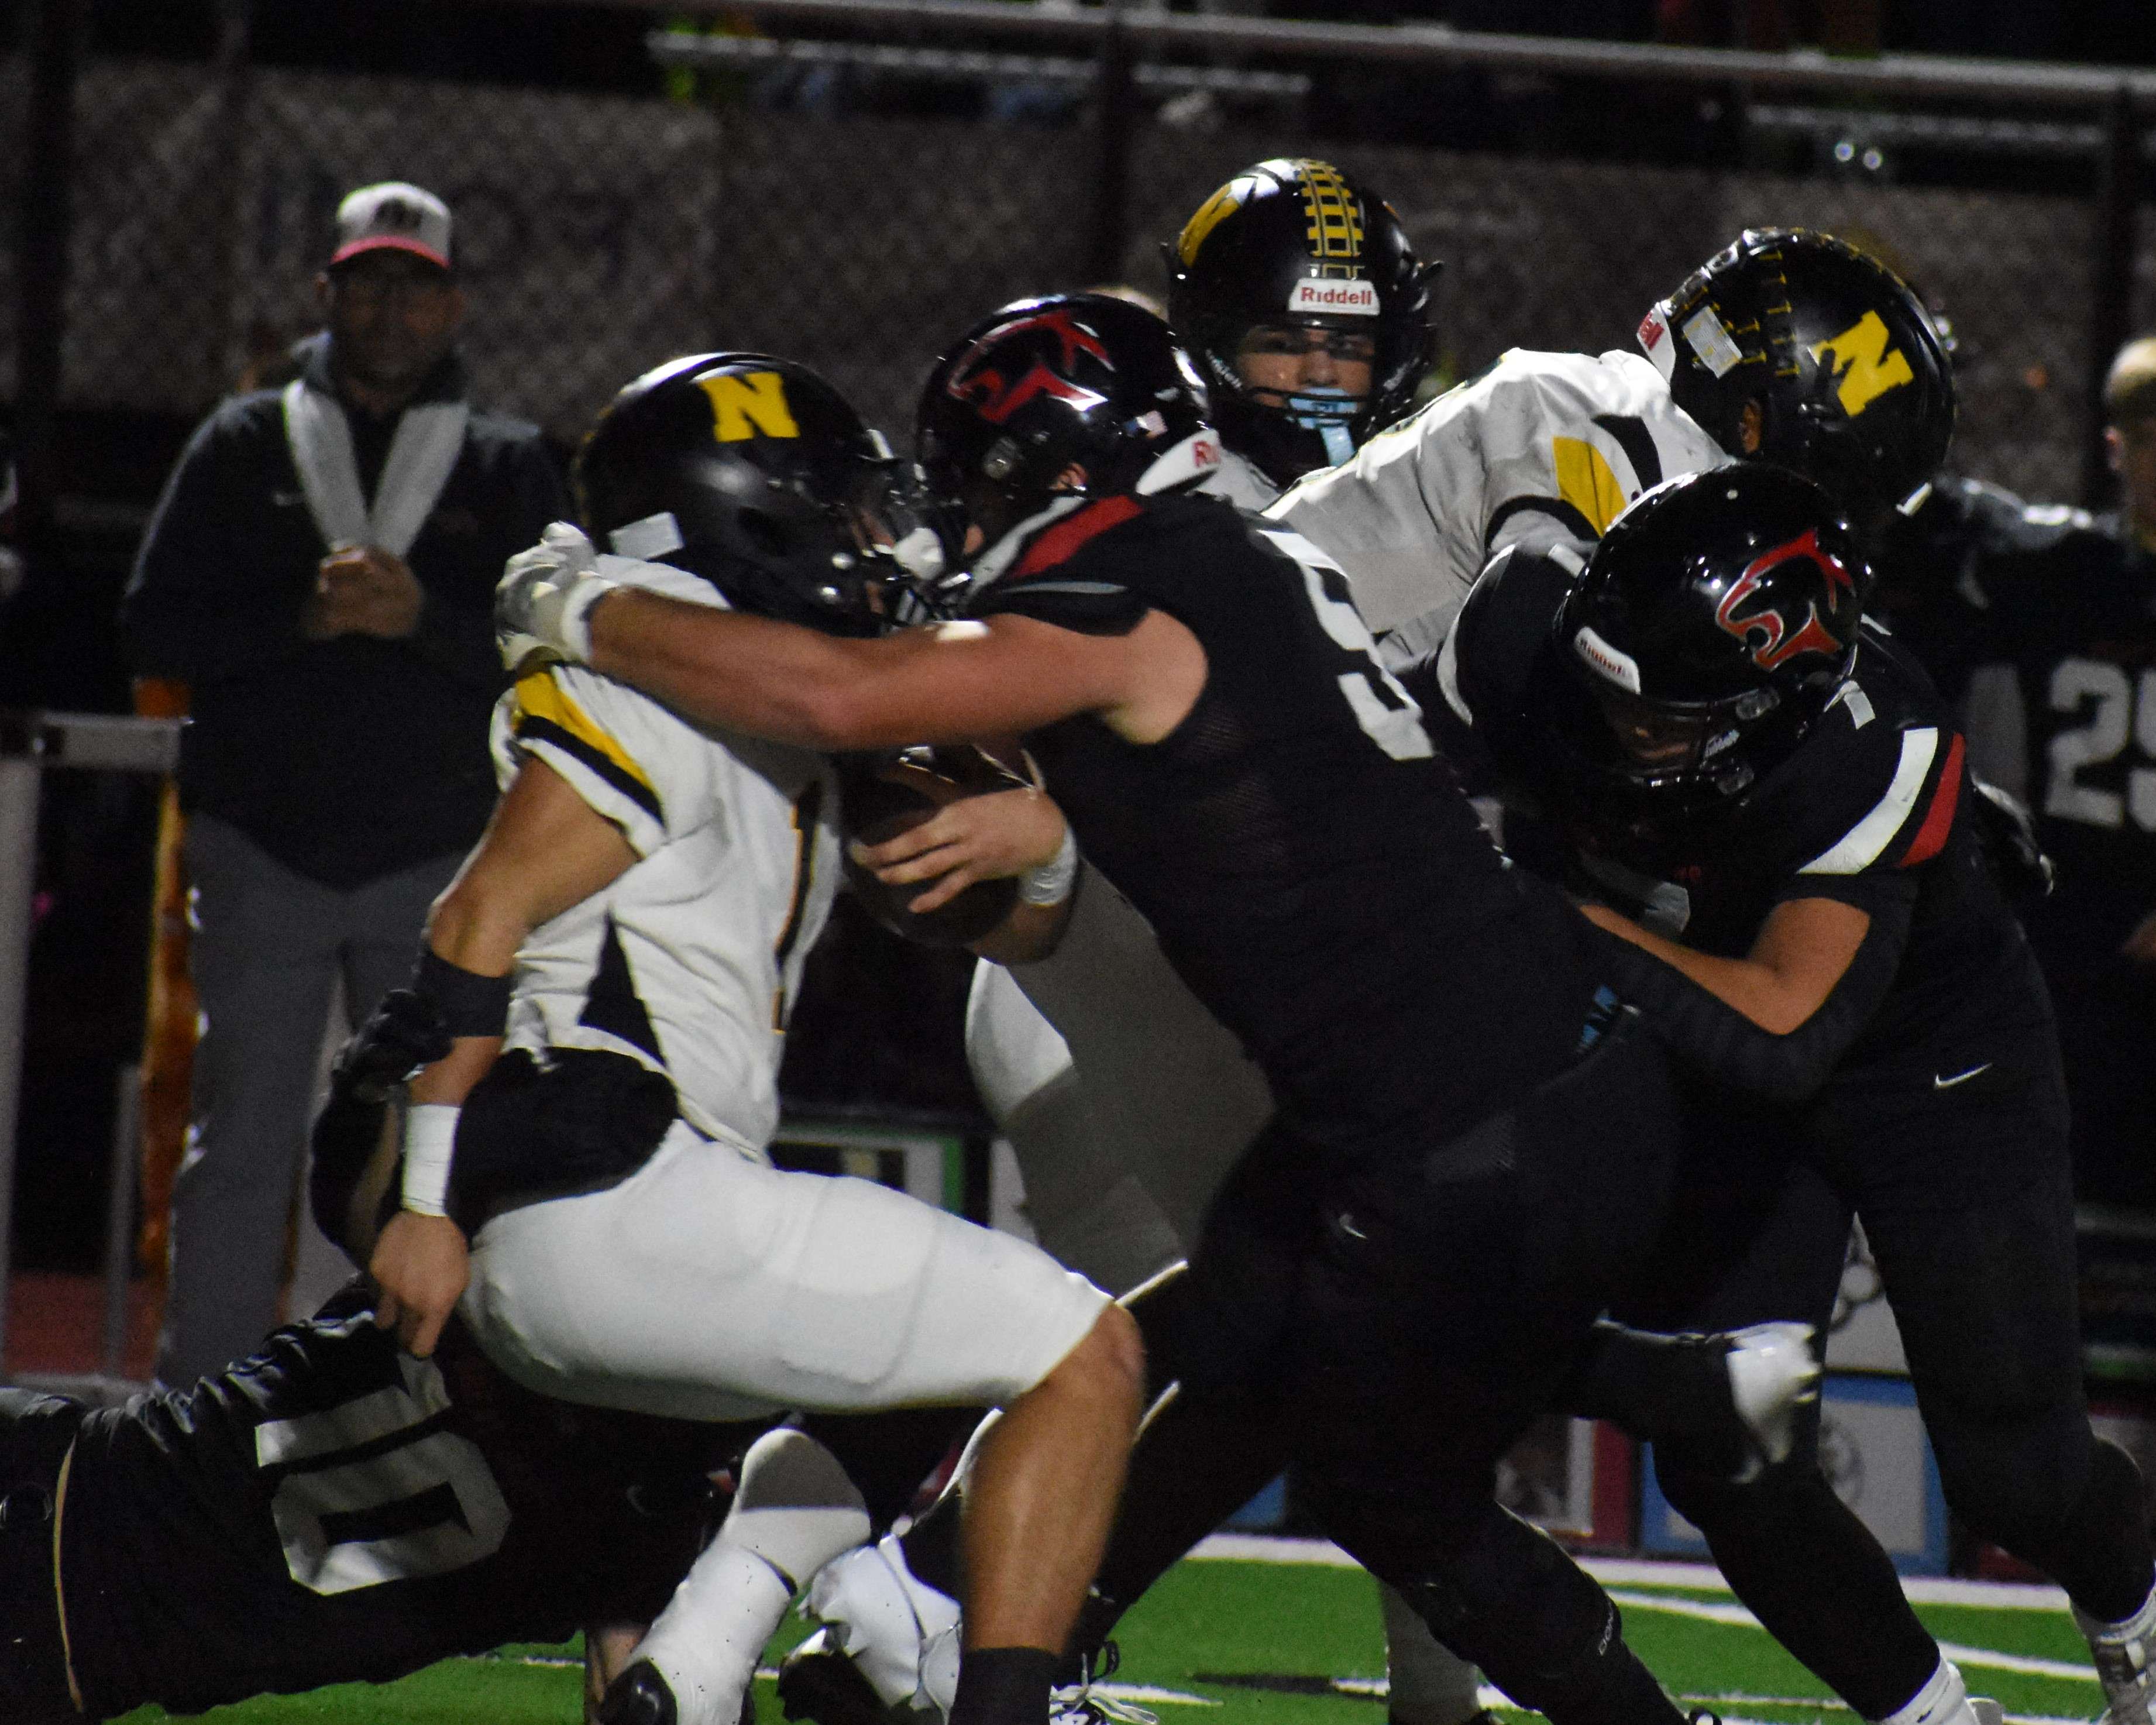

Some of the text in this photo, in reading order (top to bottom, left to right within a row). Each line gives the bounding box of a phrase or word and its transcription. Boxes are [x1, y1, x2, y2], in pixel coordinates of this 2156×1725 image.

[1301, 287, 1372, 305] Riddell
[1811, 310, 1914, 418] N
[697, 372, 800, 443] N
